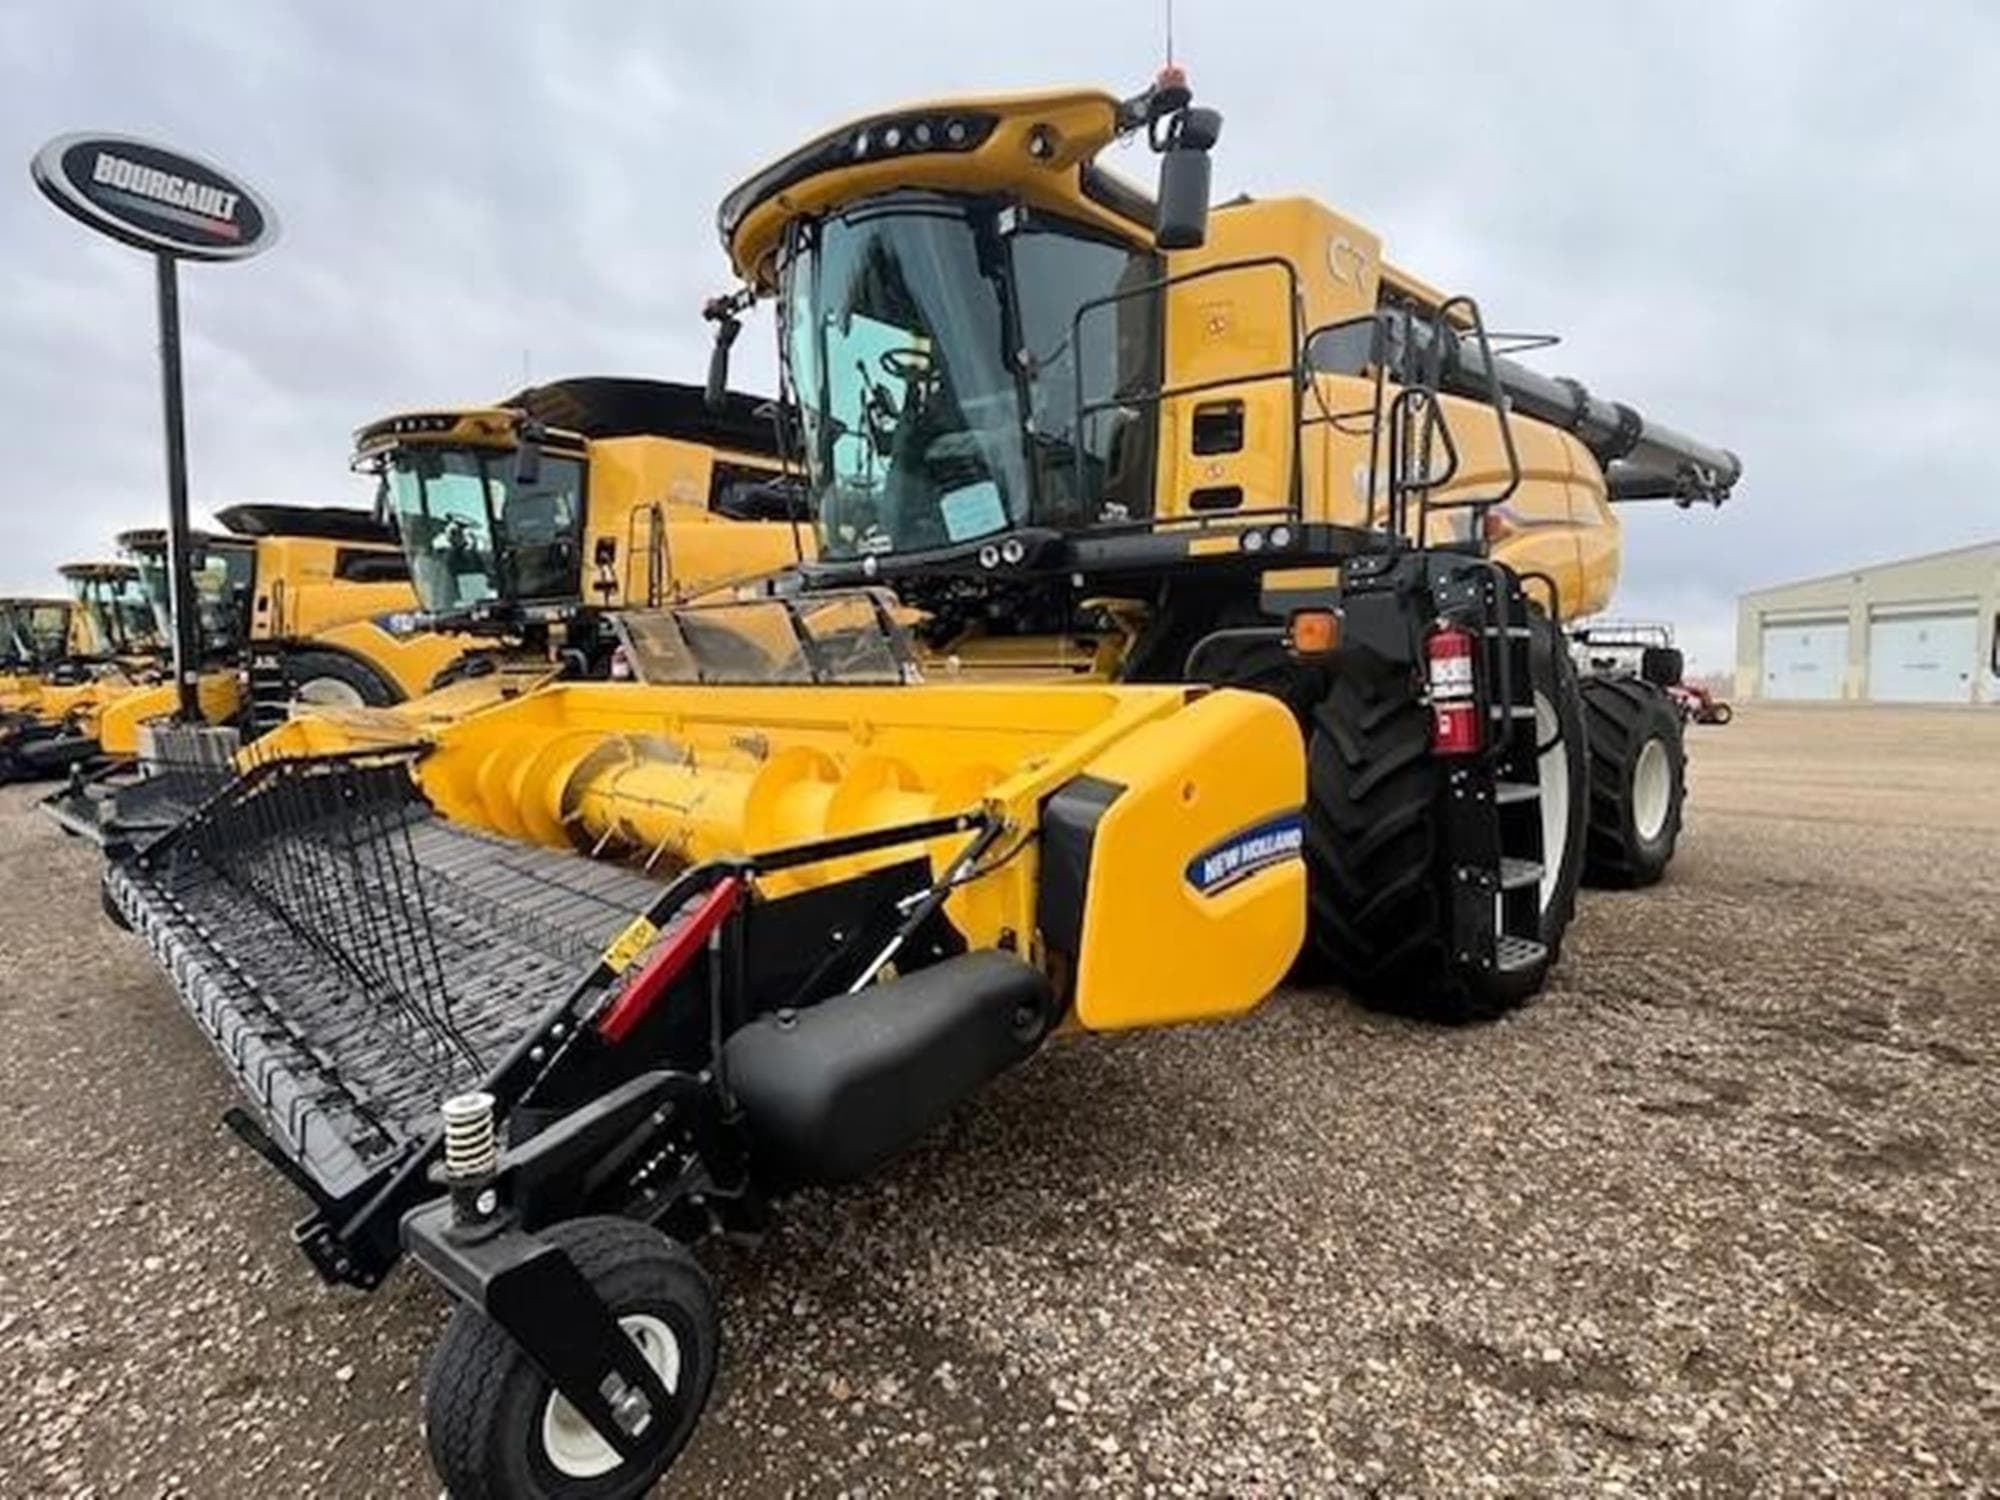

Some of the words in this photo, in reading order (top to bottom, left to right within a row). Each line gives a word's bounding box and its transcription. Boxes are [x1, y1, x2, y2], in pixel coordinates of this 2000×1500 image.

[93, 152, 240, 220] BOURGAULT
[1203, 846, 1240, 884] NEW
[1241, 827, 1303, 864] HOLLAND
